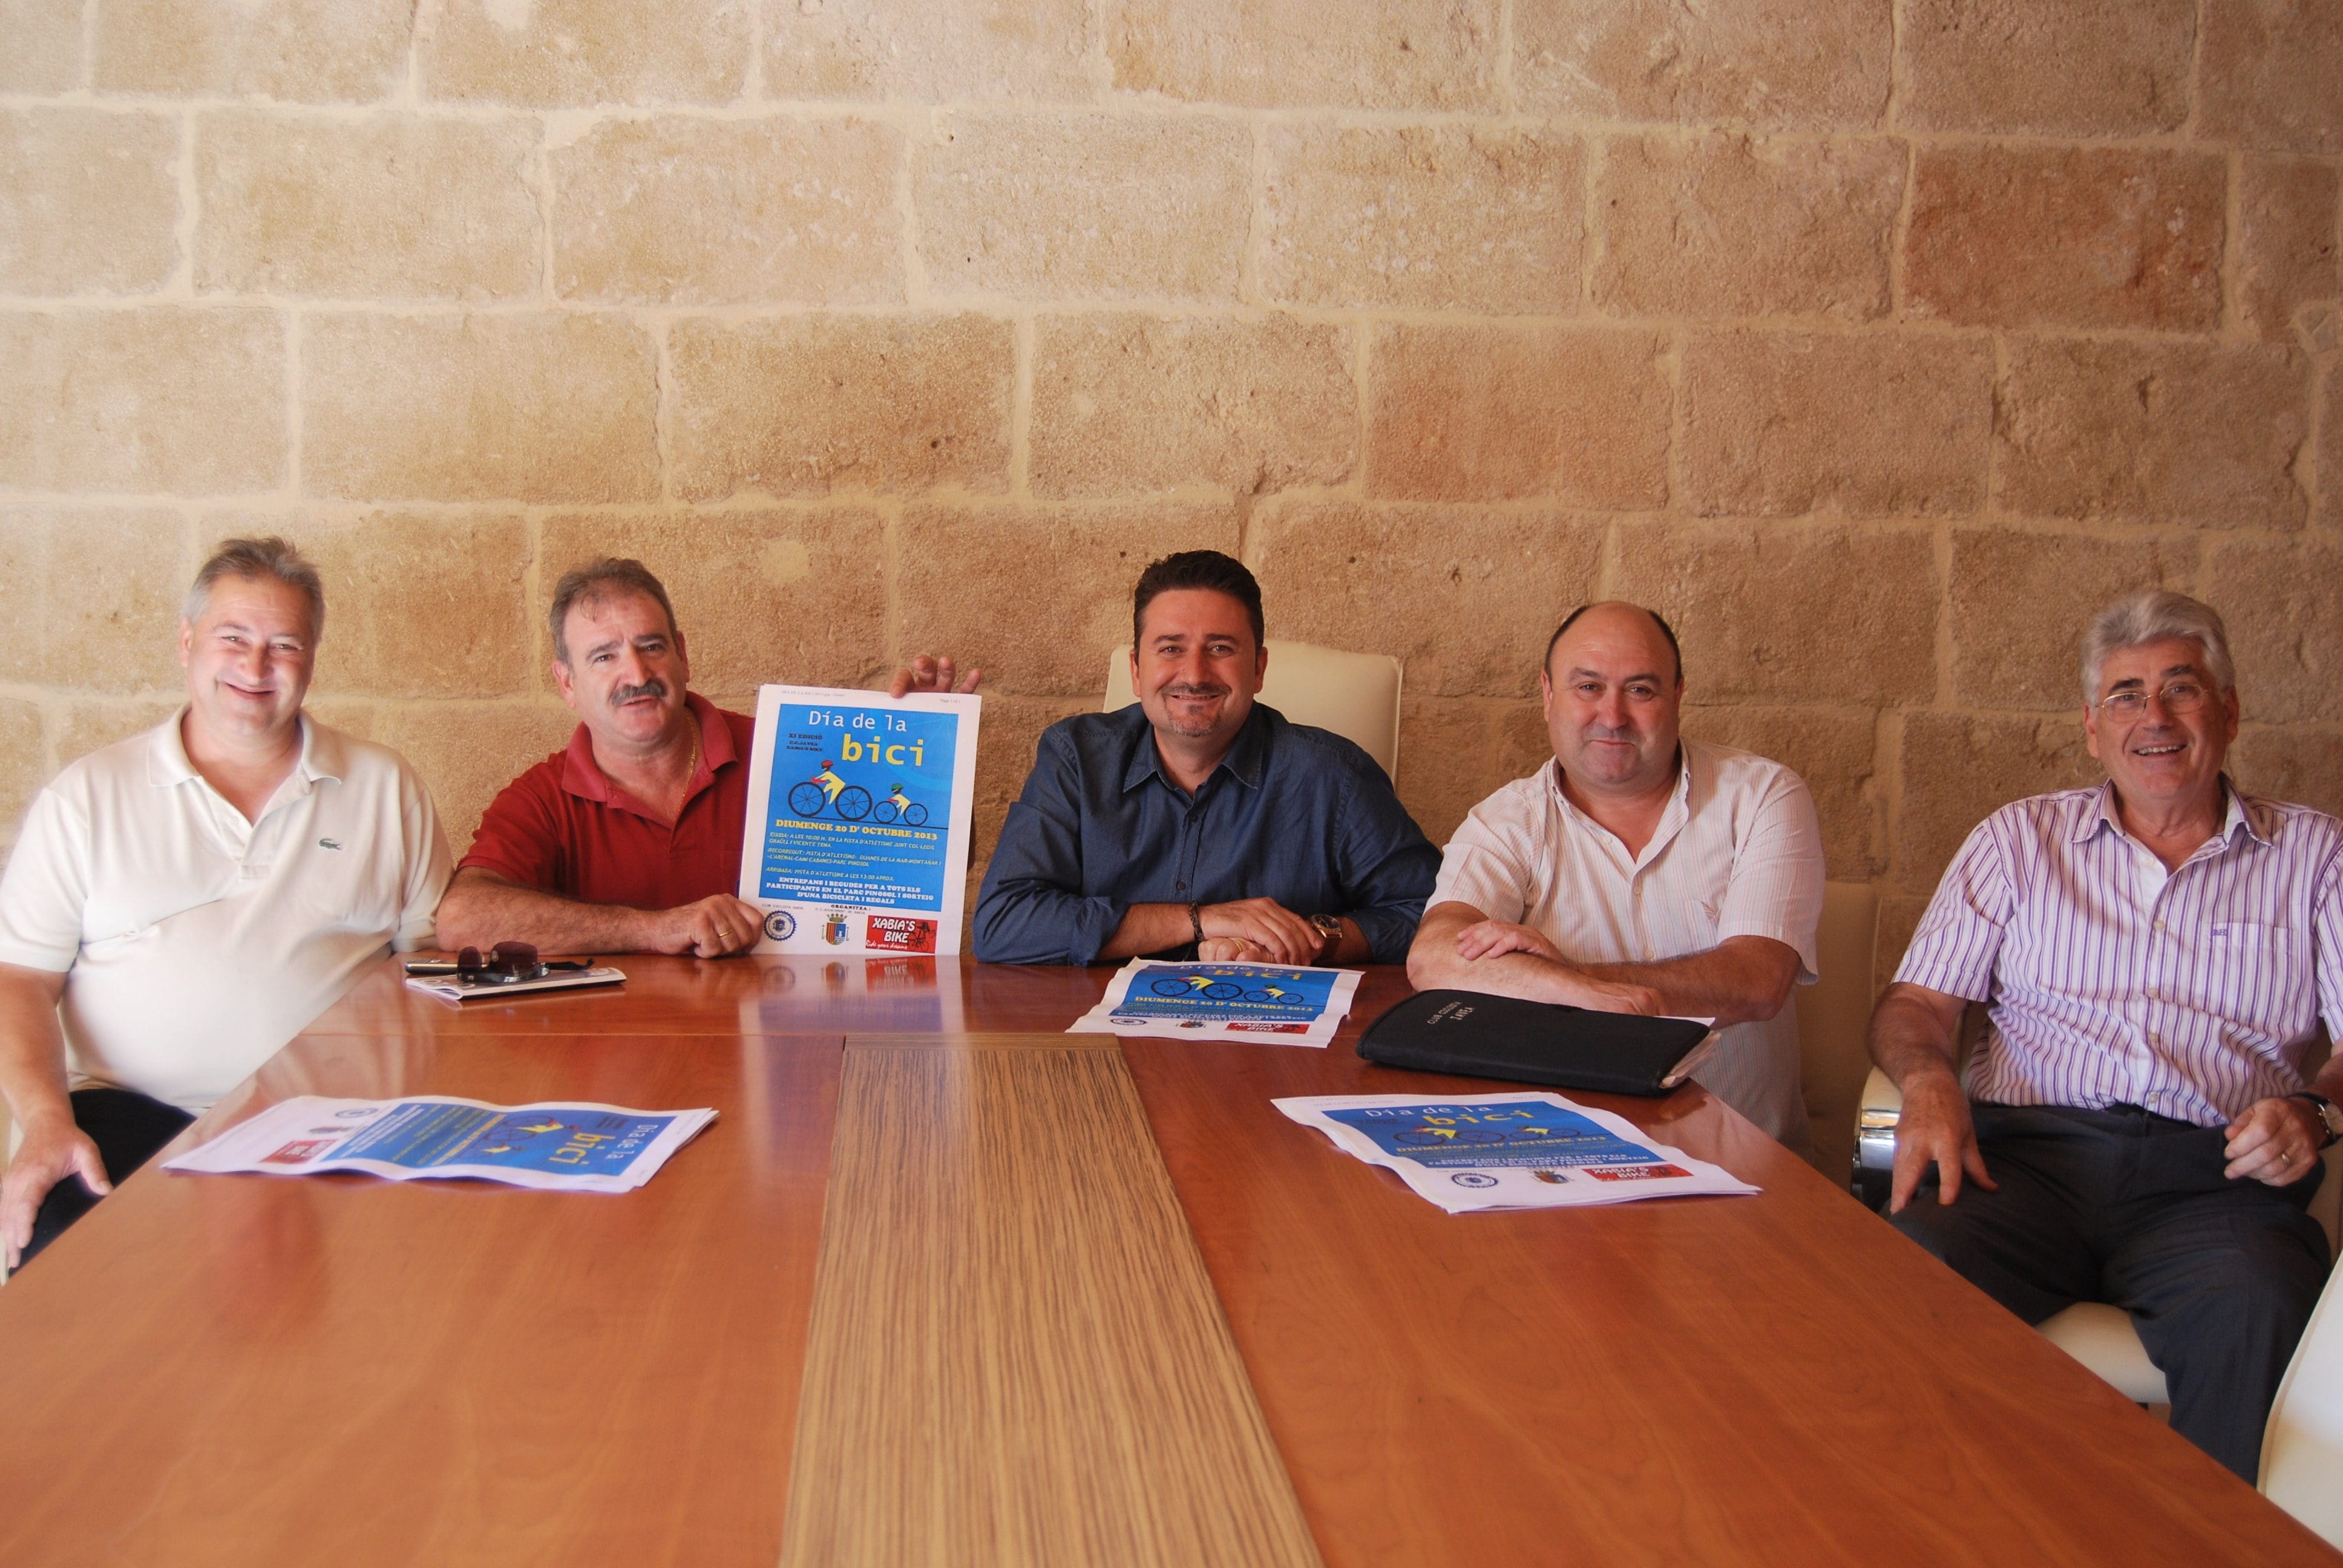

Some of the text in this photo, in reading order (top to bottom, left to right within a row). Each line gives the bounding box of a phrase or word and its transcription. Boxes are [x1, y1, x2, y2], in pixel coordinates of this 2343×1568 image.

[808, 710, 907, 732] Día de la
[842, 733, 924, 766] bici
[776, 819, 833, 831] DIUMENGE
[862, 826, 912, 838] OCTUBRE
[914, 831, 938, 840] 2013
[766, 882, 821, 892] PARTICIPANTS
[779, 877, 824, 886] ENTREPANS
[822, 893, 860, 902] BICICLETA
[872, 917, 916, 932] XABIA'S
[883, 930, 910, 944] BIKE
[1214, 969, 1302, 981] bici
[1135, 996, 1198, 1005] DIUMENGE
[1365, 1108, 1415, 1117] Día
[1422, 1105, 1453, 1114] de
[1422, 1109, 1535, 1125] bici
[548, 1132, 617, 1165] bici
